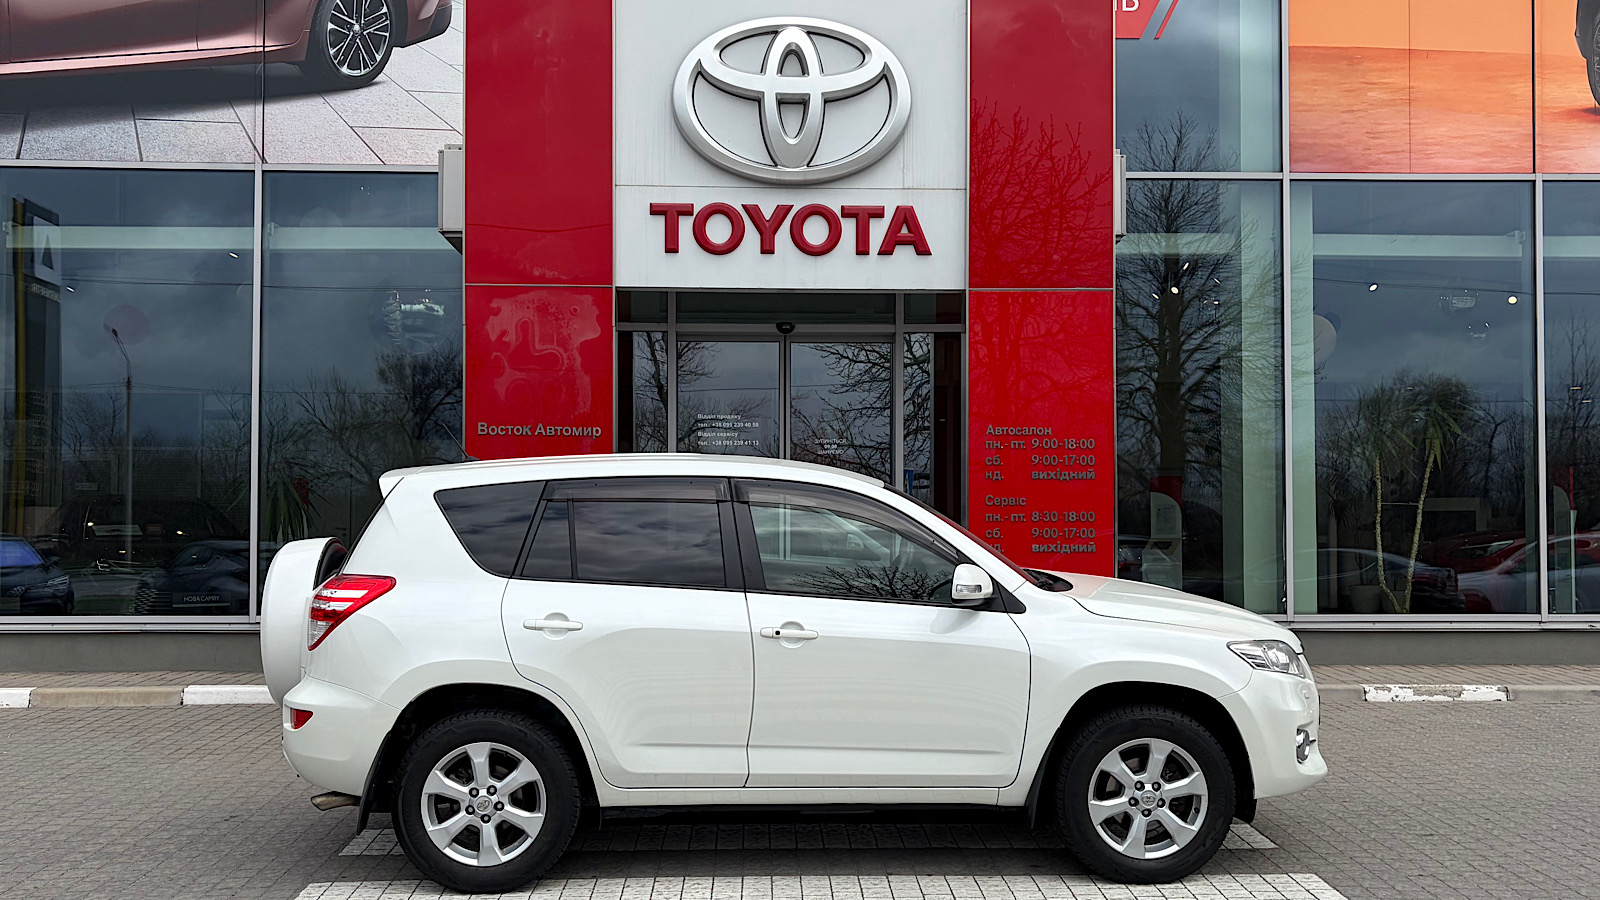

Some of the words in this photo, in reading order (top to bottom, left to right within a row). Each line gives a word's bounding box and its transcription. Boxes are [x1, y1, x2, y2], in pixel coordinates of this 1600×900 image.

[649, 202, 932, 256] TOYOTA
[477, 422, 532, 436] Восток
[534, 423, 602, 440] Автомир
[985, 424, 1052, 435] Автосалон
[1031, 438, 1096, 449] 9:00-18:00
[985, 455, 1004, 466] сб.
[1031, 455, 1096, 466] 9:00-17:00
[985, 470, 1005, 481] нд.
[1031, 468, 1096, 481] вихідний
[985, 495, 1027, 507] Сервіс
[985, 527, 1004, 538] сб.
[1031, 527, 1096, 539] 9:00-17:00
[1031, 541, 1096, 554] вихідний
